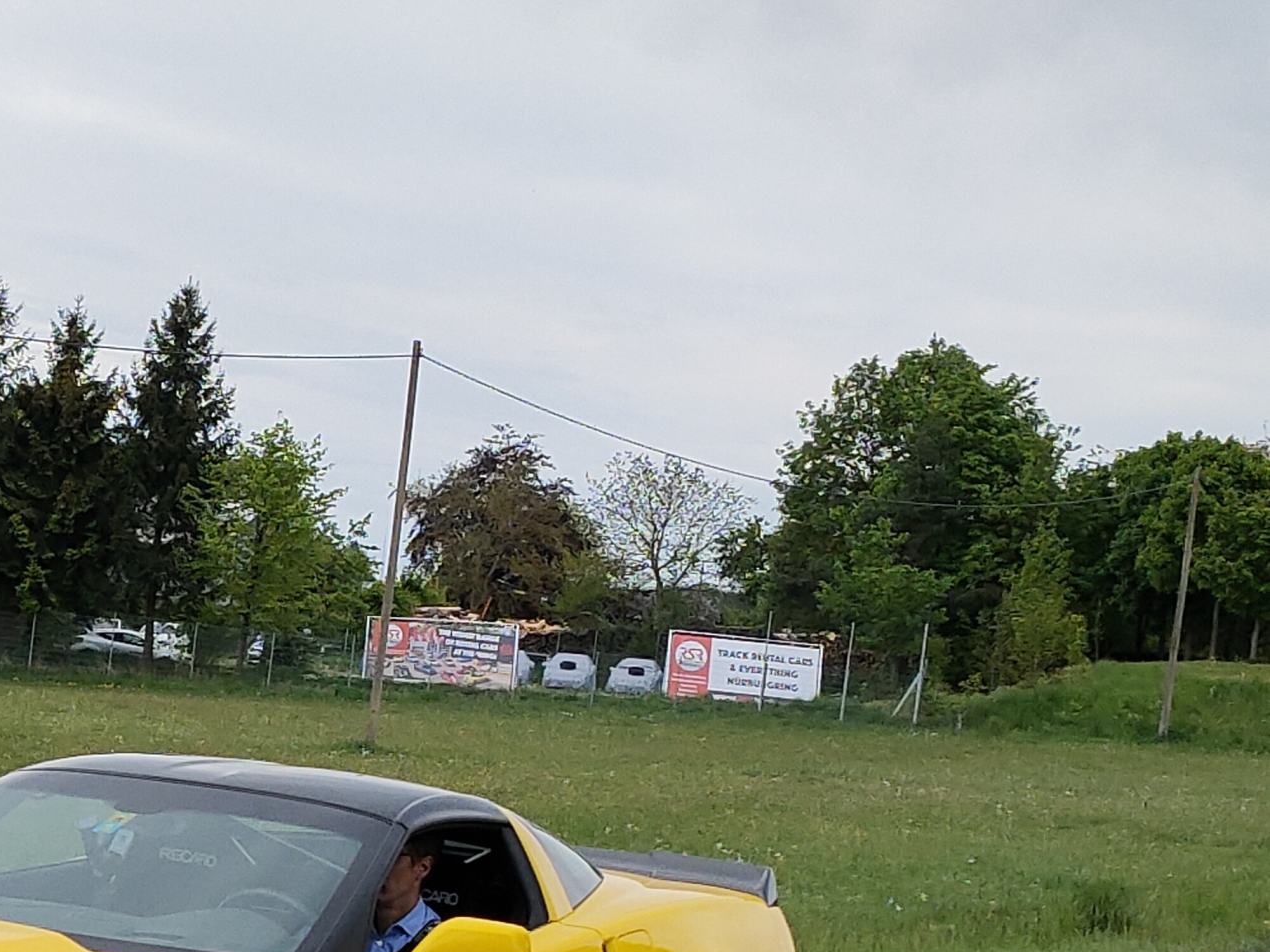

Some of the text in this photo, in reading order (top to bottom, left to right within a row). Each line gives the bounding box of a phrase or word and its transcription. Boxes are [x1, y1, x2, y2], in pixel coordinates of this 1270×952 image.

[718, 649, 749, 660] TRACK
[788, 657, 813, 666] CARS
[739, 665, 799, 678] EVERTHING
[158, 846, 217, 868] RECARO
